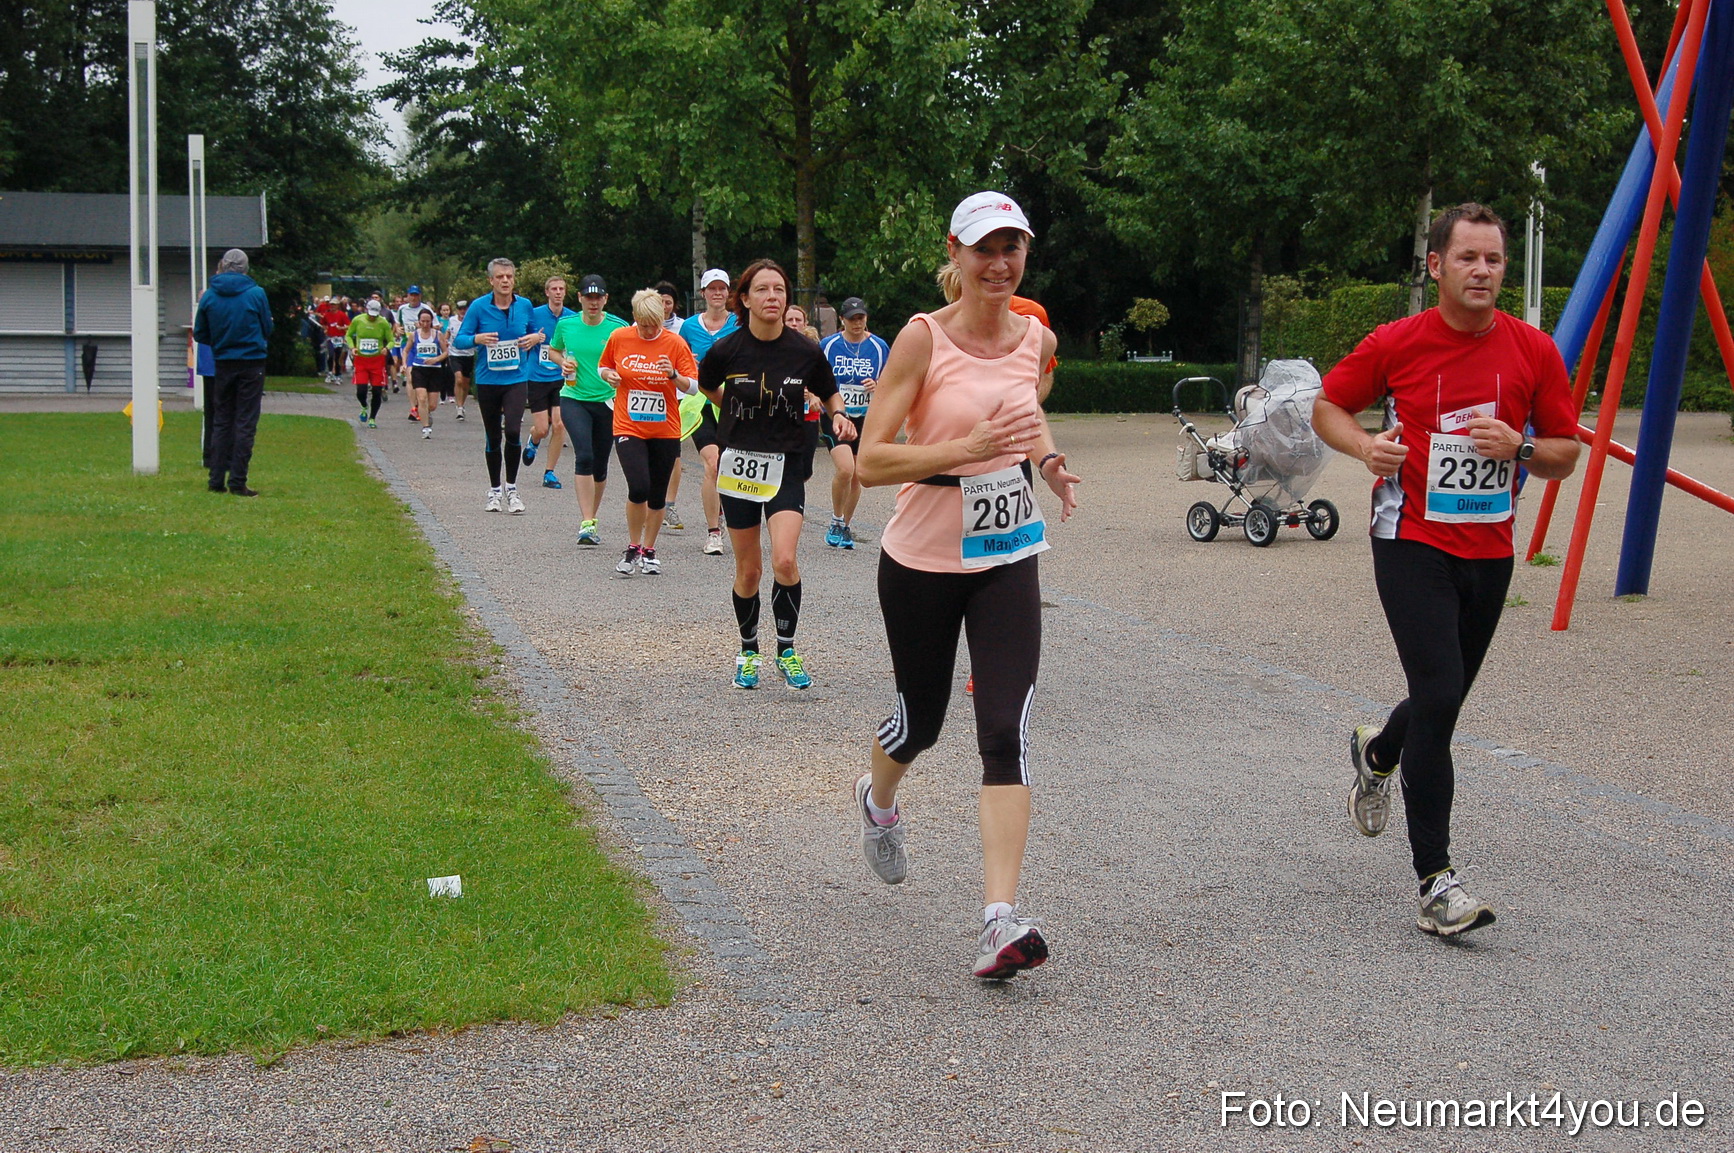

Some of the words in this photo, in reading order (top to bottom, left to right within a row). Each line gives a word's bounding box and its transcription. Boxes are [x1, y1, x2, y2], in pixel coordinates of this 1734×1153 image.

[490, 347, 517, 360] 2356
[835, 355, 871, 366] Fitness
[832, 365, 874, 377] CORNER
[631, 397, 665, 412] 2779
[843, 392, 871, 406] 2404
[1432, 443, 1465, 453] PARTL
[732, 456, 770, 481] 381
[1438, 457, 1511, 490] 2326
[737, 482, 759, 494] Karin
[963, 483, 996, 496] PARTL
[972, 485, 1033, 532] 2870
[1457, 498, 1493, 511] Oliver
